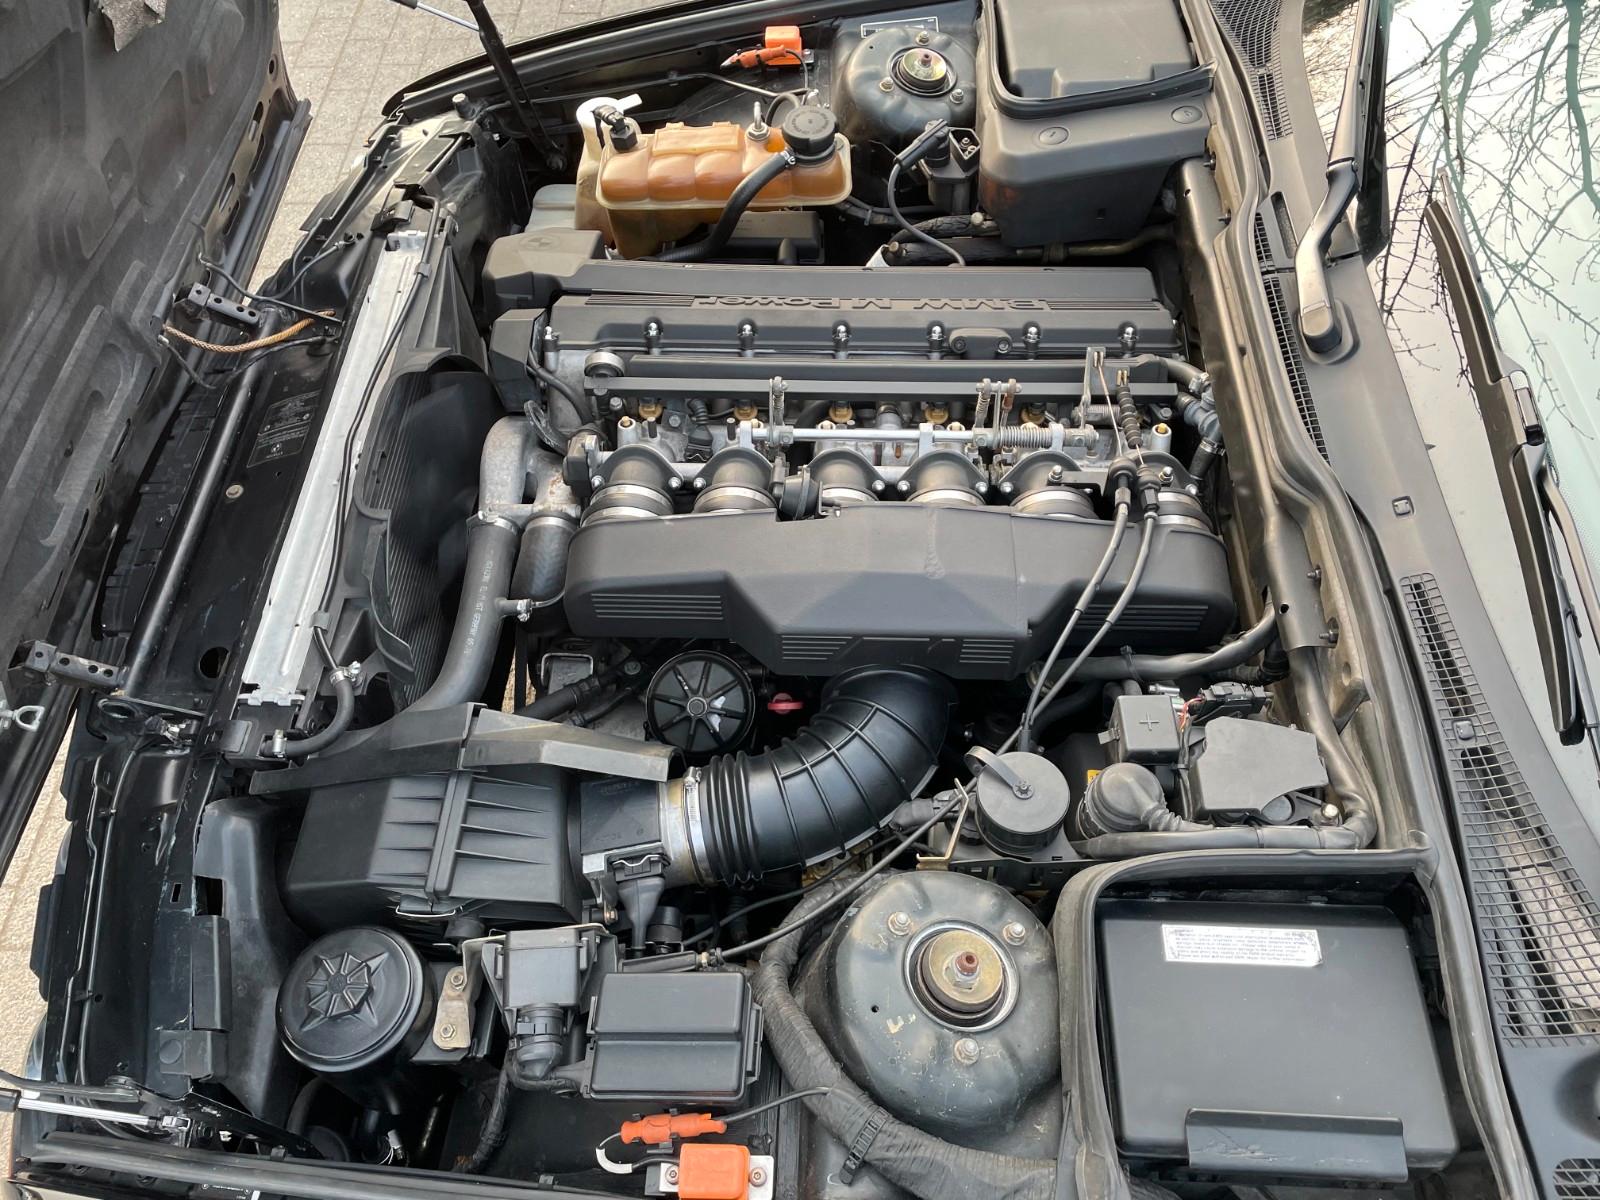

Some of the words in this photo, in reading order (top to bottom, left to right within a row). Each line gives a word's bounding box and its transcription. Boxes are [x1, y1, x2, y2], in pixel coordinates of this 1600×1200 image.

[698, 296, 841, 309] Power
[852, 298, 892, 309] M
[912, 298, 1044, 310] BMW
